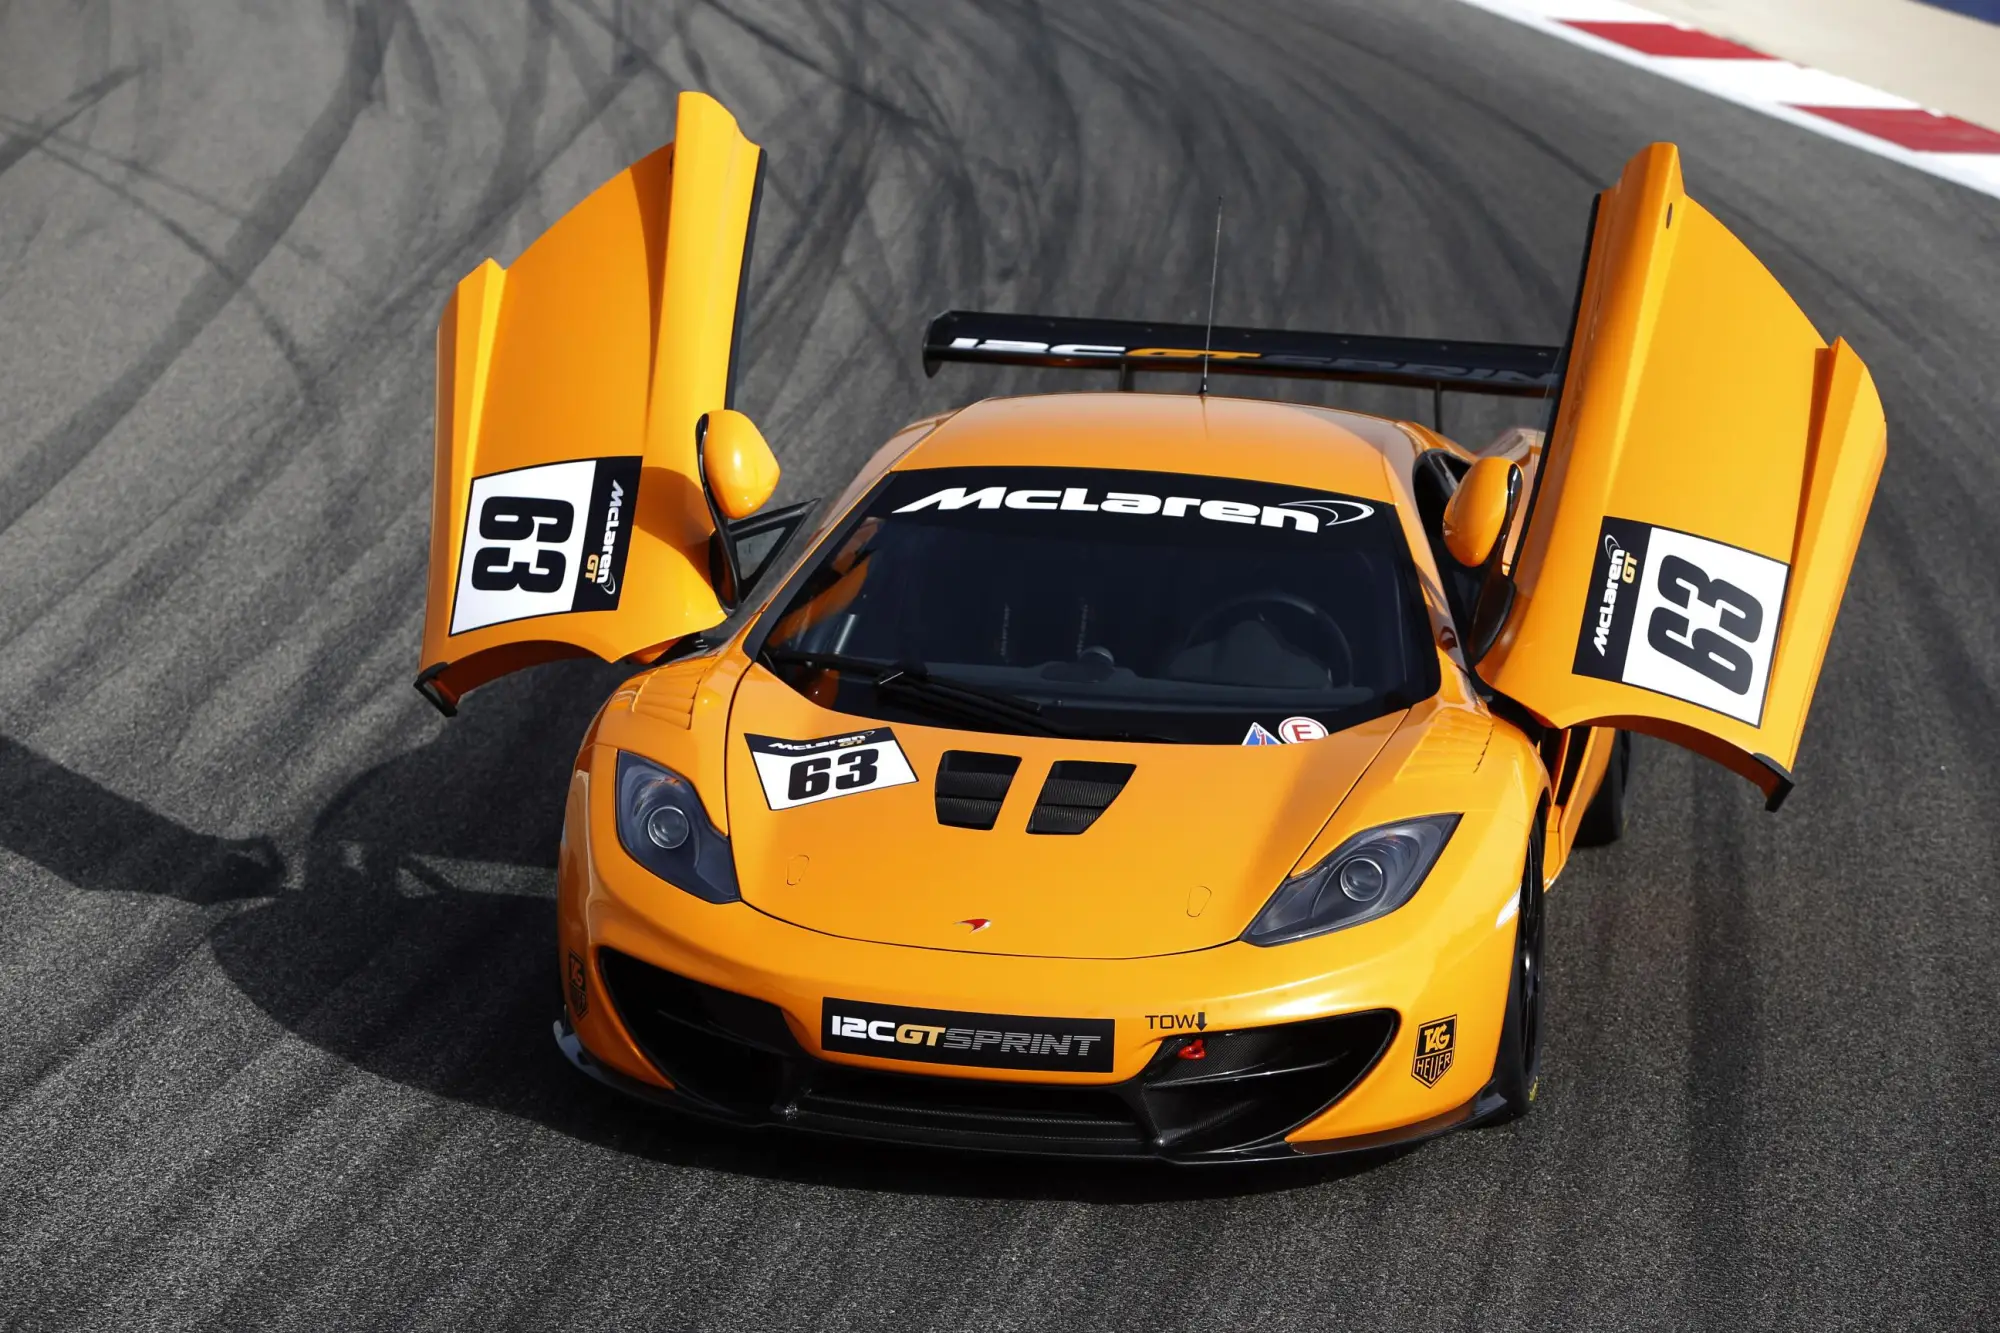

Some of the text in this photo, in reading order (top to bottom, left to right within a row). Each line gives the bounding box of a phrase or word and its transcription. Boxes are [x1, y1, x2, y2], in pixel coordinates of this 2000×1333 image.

[892, 486, 1320, 534] McLaren
[471, 495, 575, 594] 63
[597, 479, 624, 584] McLaren
[585, 554, 599, 584] GT
[1622, 551, 1638, 584] GT
[1593, 548, 1626, 657] McLaren
[1647, 554, 1764, 696] 63
[768, 735, 866, 751] McLaren
[1291, 724, 1317, 742] E
[787, 748, 879, 801] 63
[1144, 1014, 1196, 1030] TOW
[1424, 1023, 1450, 1054] TAG
[1416, 1053, 1451, 1083] HEUER
